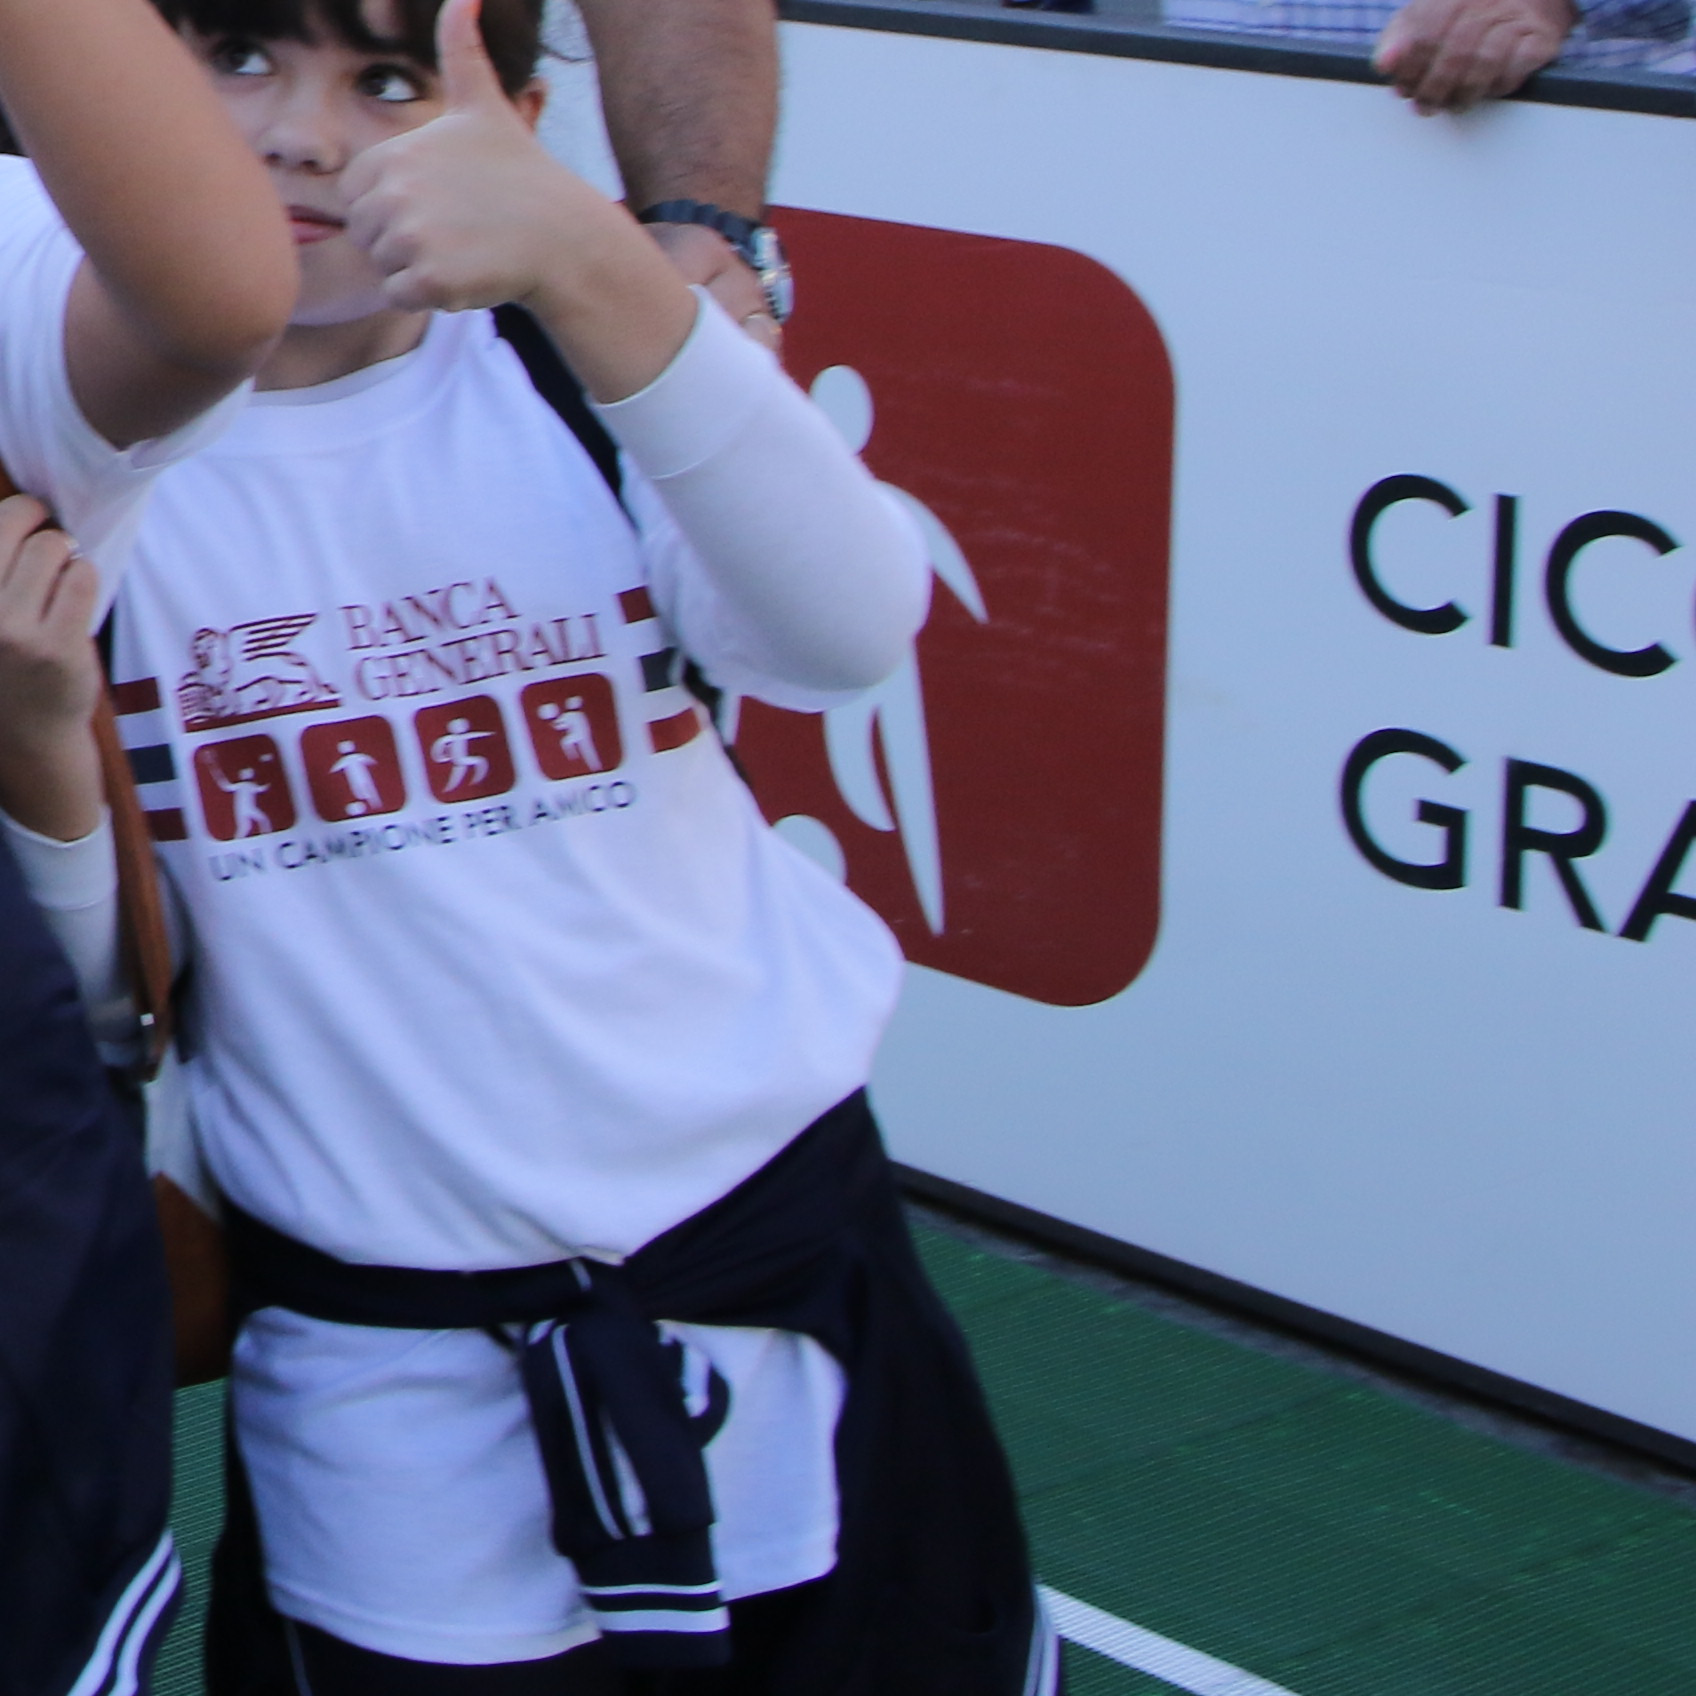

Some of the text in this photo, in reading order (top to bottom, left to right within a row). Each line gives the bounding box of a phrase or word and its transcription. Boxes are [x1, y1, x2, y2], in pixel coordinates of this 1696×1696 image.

[339, 578, 522, 651] BANCA
[1348, 472, 1696, 679] CIC
[355, 612, 608, 702] GENERALI
[208, 779, 637, 882] UN CAMPIONE PER AMICO
